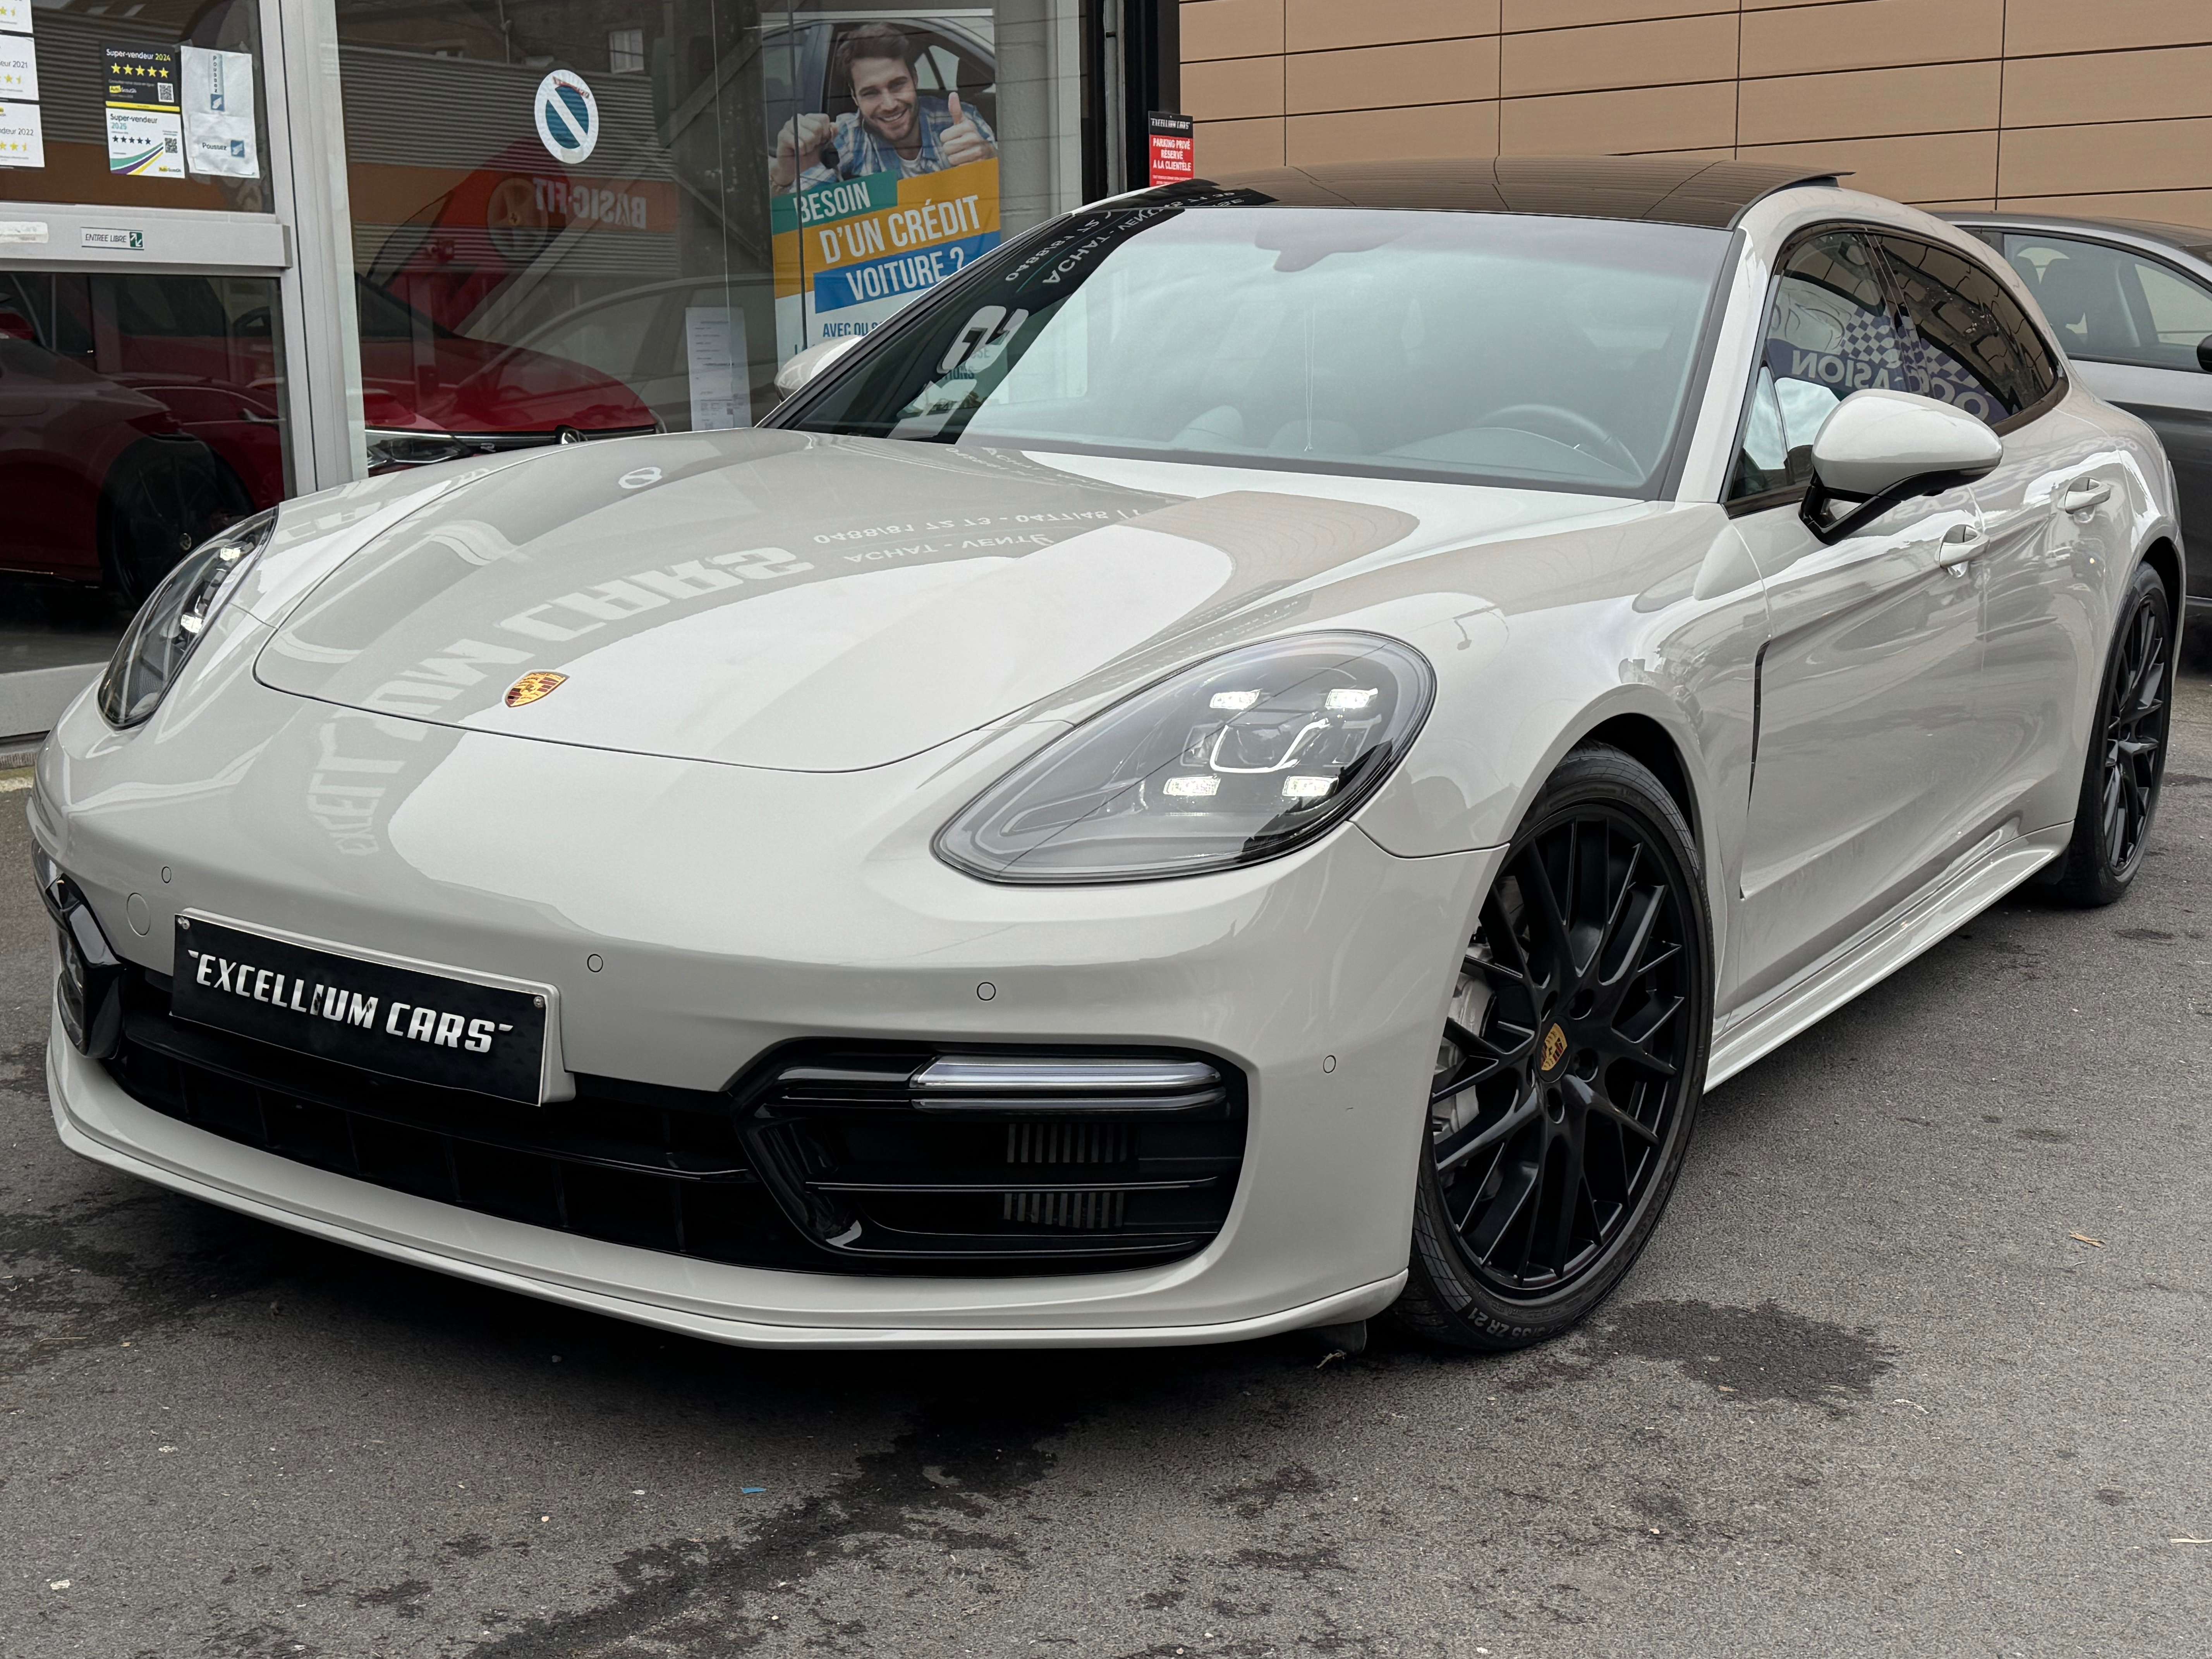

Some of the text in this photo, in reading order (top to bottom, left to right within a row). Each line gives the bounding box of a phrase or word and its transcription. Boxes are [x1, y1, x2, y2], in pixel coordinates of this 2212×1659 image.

[106, 48, 171, 61] Super-vendeur 2024
[110, 113, 158, 124] Super-vendeur
[202, 142, 227, 151] Poussez
[1153, 137, 1175, 148] PARKING
[1158, 160, 1164, 169] LA
[793, 181, 871, 223] BESOIN
[888, 194, 980, 248] CRÉDIT
[846, 251, 948, 301] VOITURE
[823, 322, 851, 337] AVEC
[854, 322, 868, 336] OU
[196, 953, 495, 1053] EXCELLIUM CARS
